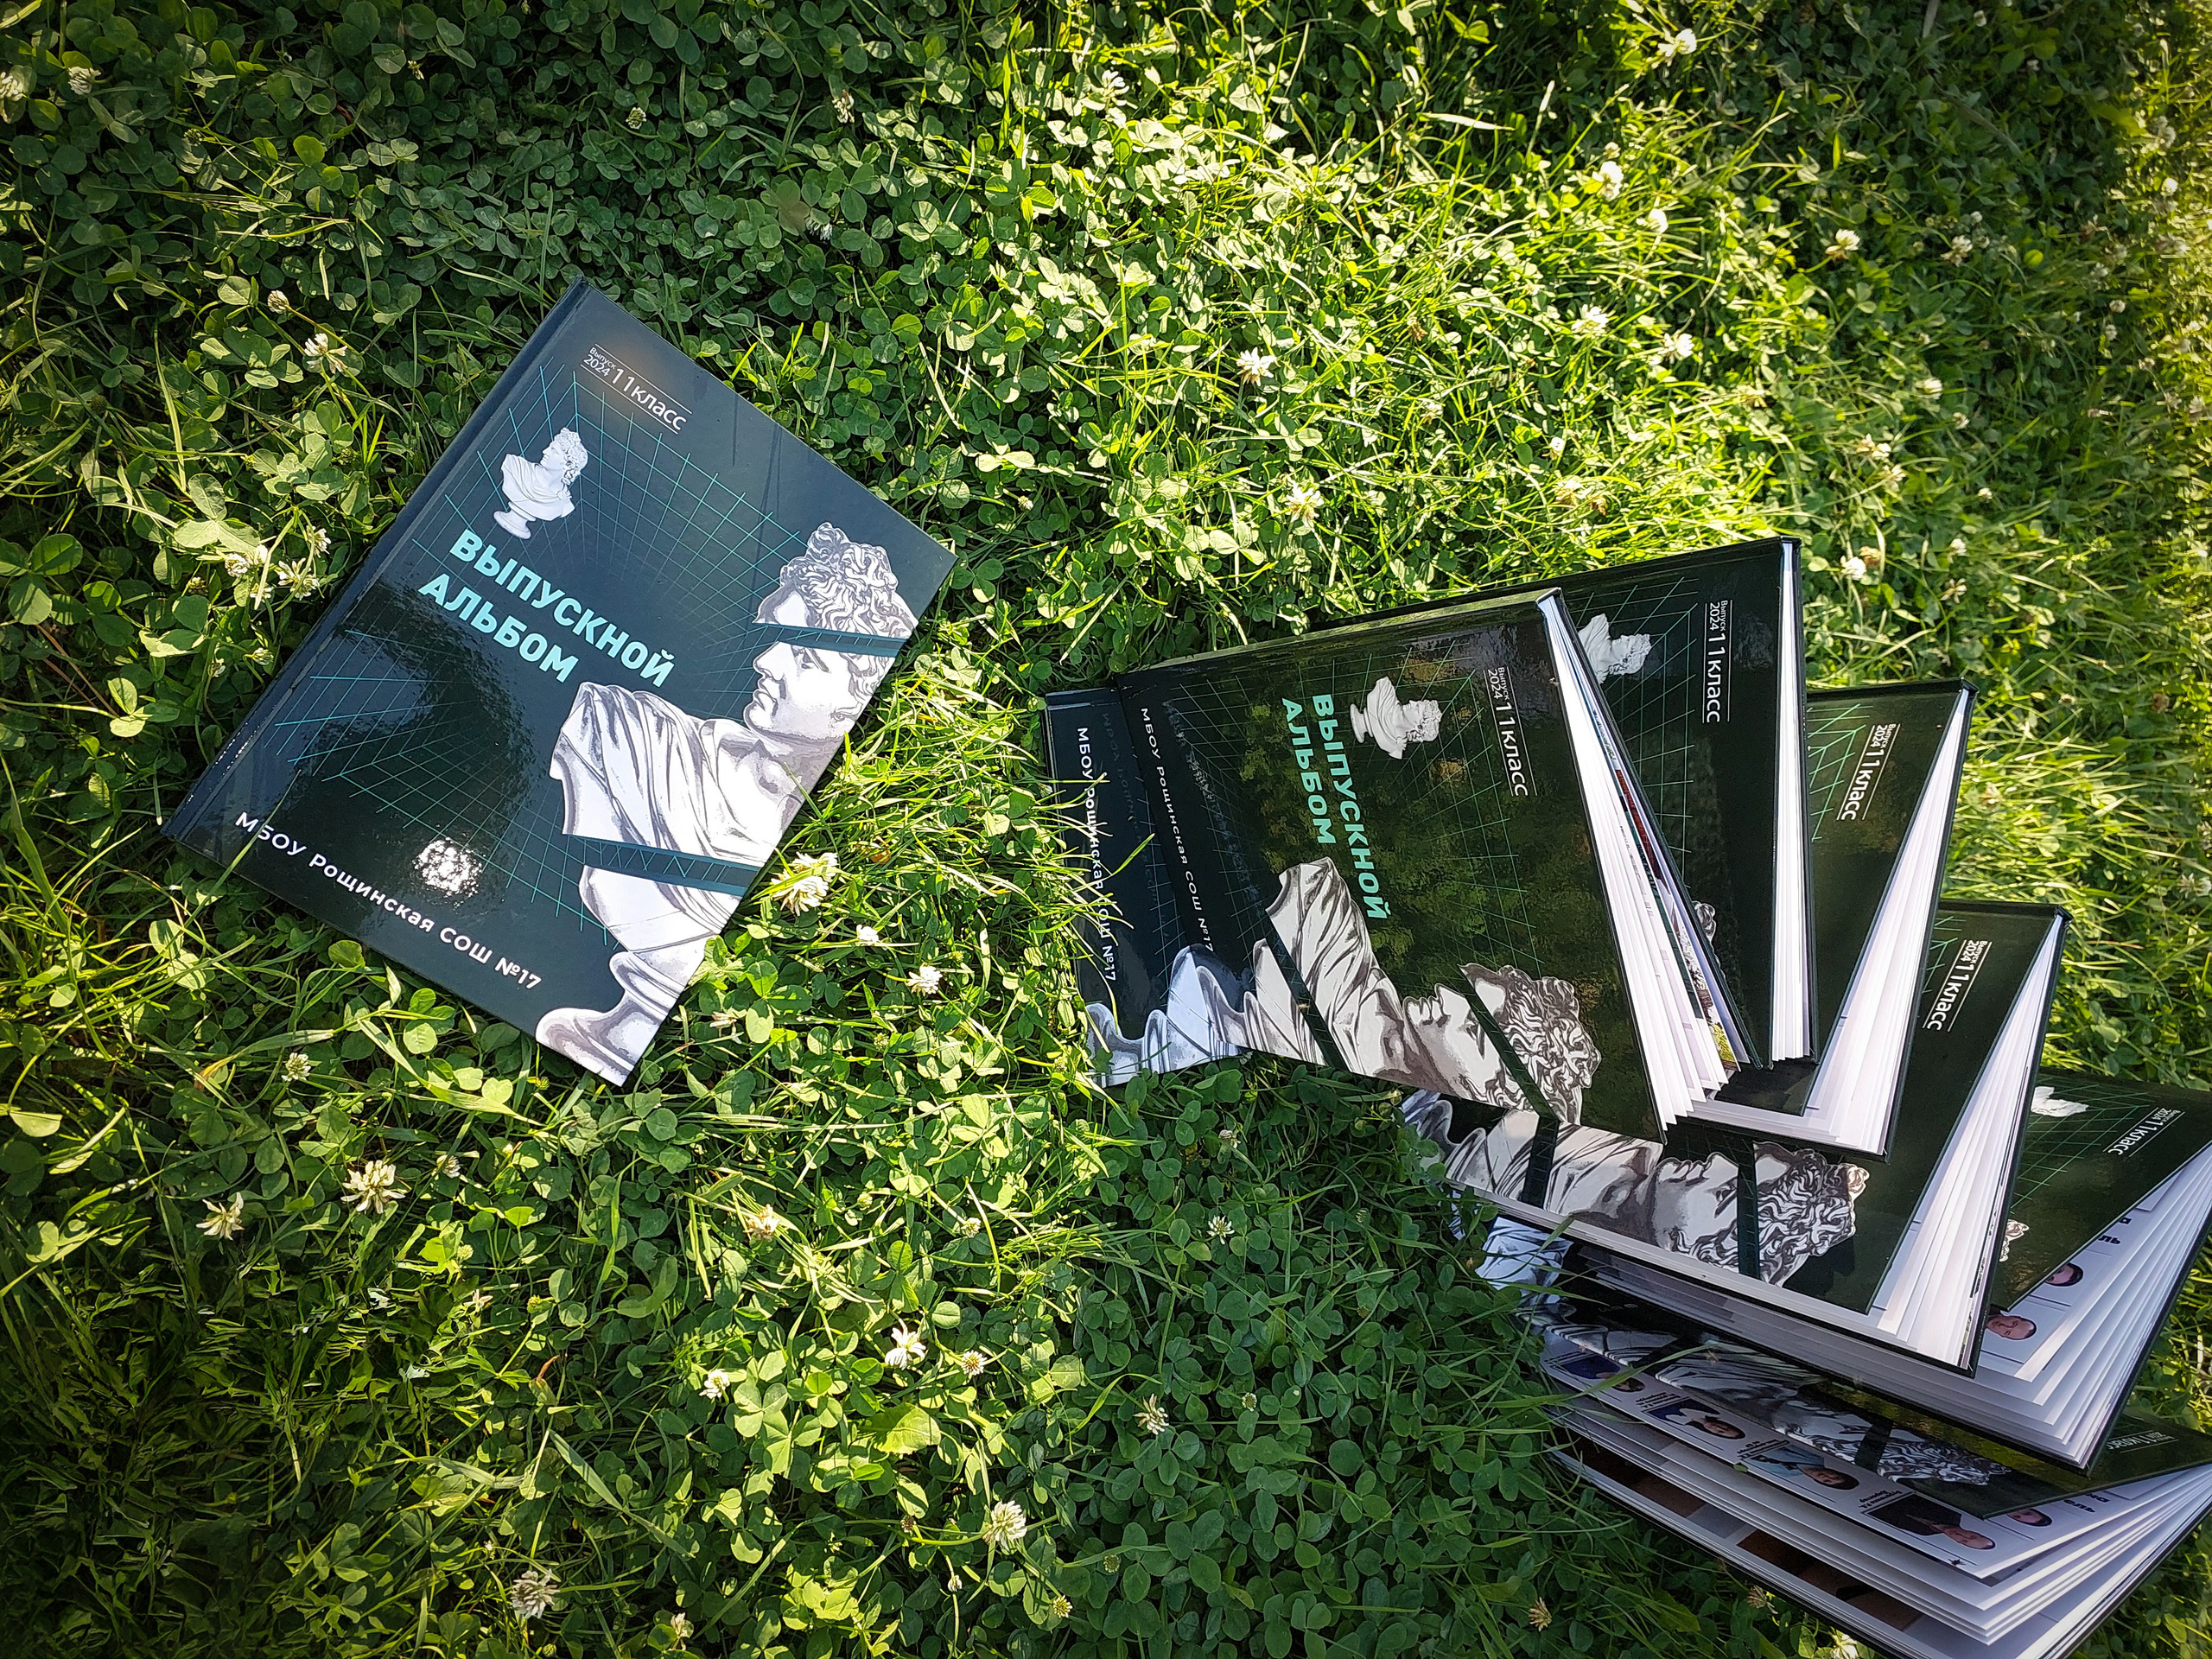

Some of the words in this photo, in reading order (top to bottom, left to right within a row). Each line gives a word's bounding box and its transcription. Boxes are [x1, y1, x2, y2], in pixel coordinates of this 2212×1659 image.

[583, 354, 610, 377] 2024
[589, 347, 617, 370] Выпуск
[449, 529, 675, 688] ВЫПУСКНОЙ
[1709, 602, 1719, 631] 2024
[1719, 600, 1728, 632] Выпуск
[417, 573, 579, 683] АЛЬБОМ
[1488, 669, 1503, 700] 2024
[1497, 667, 1510, 701] Выпуск
[1870, 725, 1887, 748] 2024
[1881, 723, 1897, 748] Выпуск
[1281, 697, 1337, 844] АЛЬБОМ
[1312, 694, 1391, 919] ВЫПУСКНОЙ
[1141, 708, 1161, 760] МБОУ
[1156, 766, 1187, 865] Рощинская
[1185, 870, 1202, 911] СОШ
[1198, 917, 1213, 952] №17
[1077, 728, 1094, 780] МБОУ
[1102, 944, 1116, 982] №17
[235, 811, 307, 856] МБОУ
[308, 853, 435, 932] Рощинская
[439, 927, 493, 964] СОШ
[494, 958, 543, 990] №17
[1960, 939, 1980, 962] 2024
[1970, 940, 1988, 964] Выпуск
[2151, 1108, 2172, 1121] 2024
